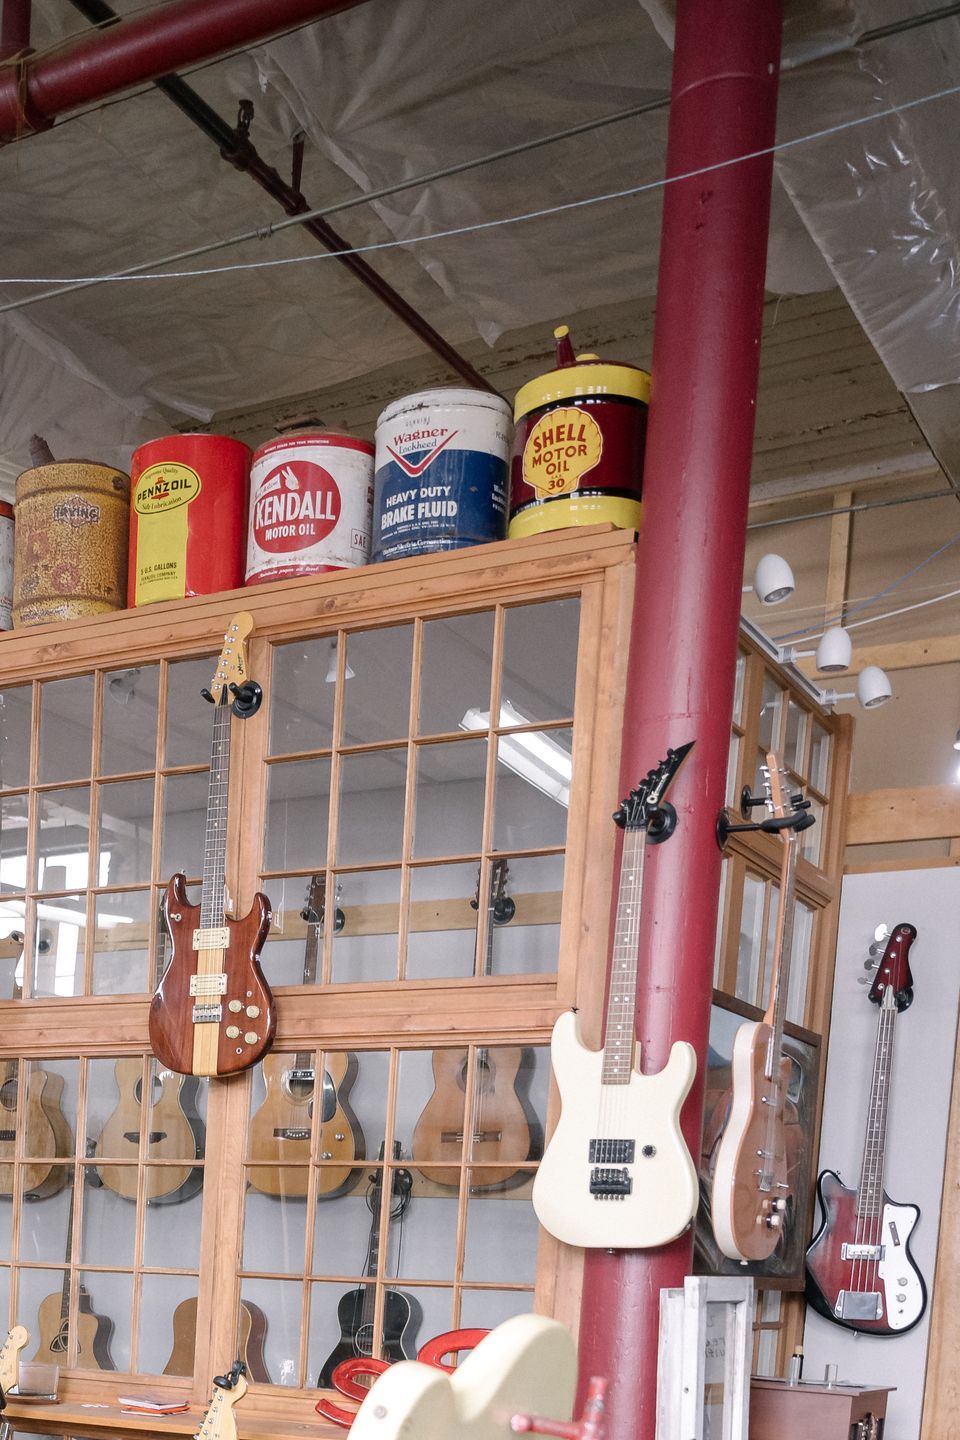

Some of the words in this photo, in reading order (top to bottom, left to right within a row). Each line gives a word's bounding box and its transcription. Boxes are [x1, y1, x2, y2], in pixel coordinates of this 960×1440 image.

[394, 428, 448, 446] Wagner
[533, 423, 587, 453] SHELL
[399, 439, 437, 454] Lockheed
[532, 444, 587, 468] MOTOR
[545, 460, 570, 475] OIL
[137, 479, 192, 504] PENNZOIL
[548, 478, 565, 490] 30
[386, 489, 417, 508] HEAVY
[420, 486, 451, 498] DUTY
[54, 506, 98, 520] IRVING
[255, 490, 336, 530] KENDALL
[381, 503, 415, 530] BRAKE
[417, 501, 458, 519] FLUID
[265, 525, 296, 541] MOTOR
[298, 523, 316, 536] OIL
[354, 533, 366, 548] SAE
[153, 562, 177, 571] GALLONS
